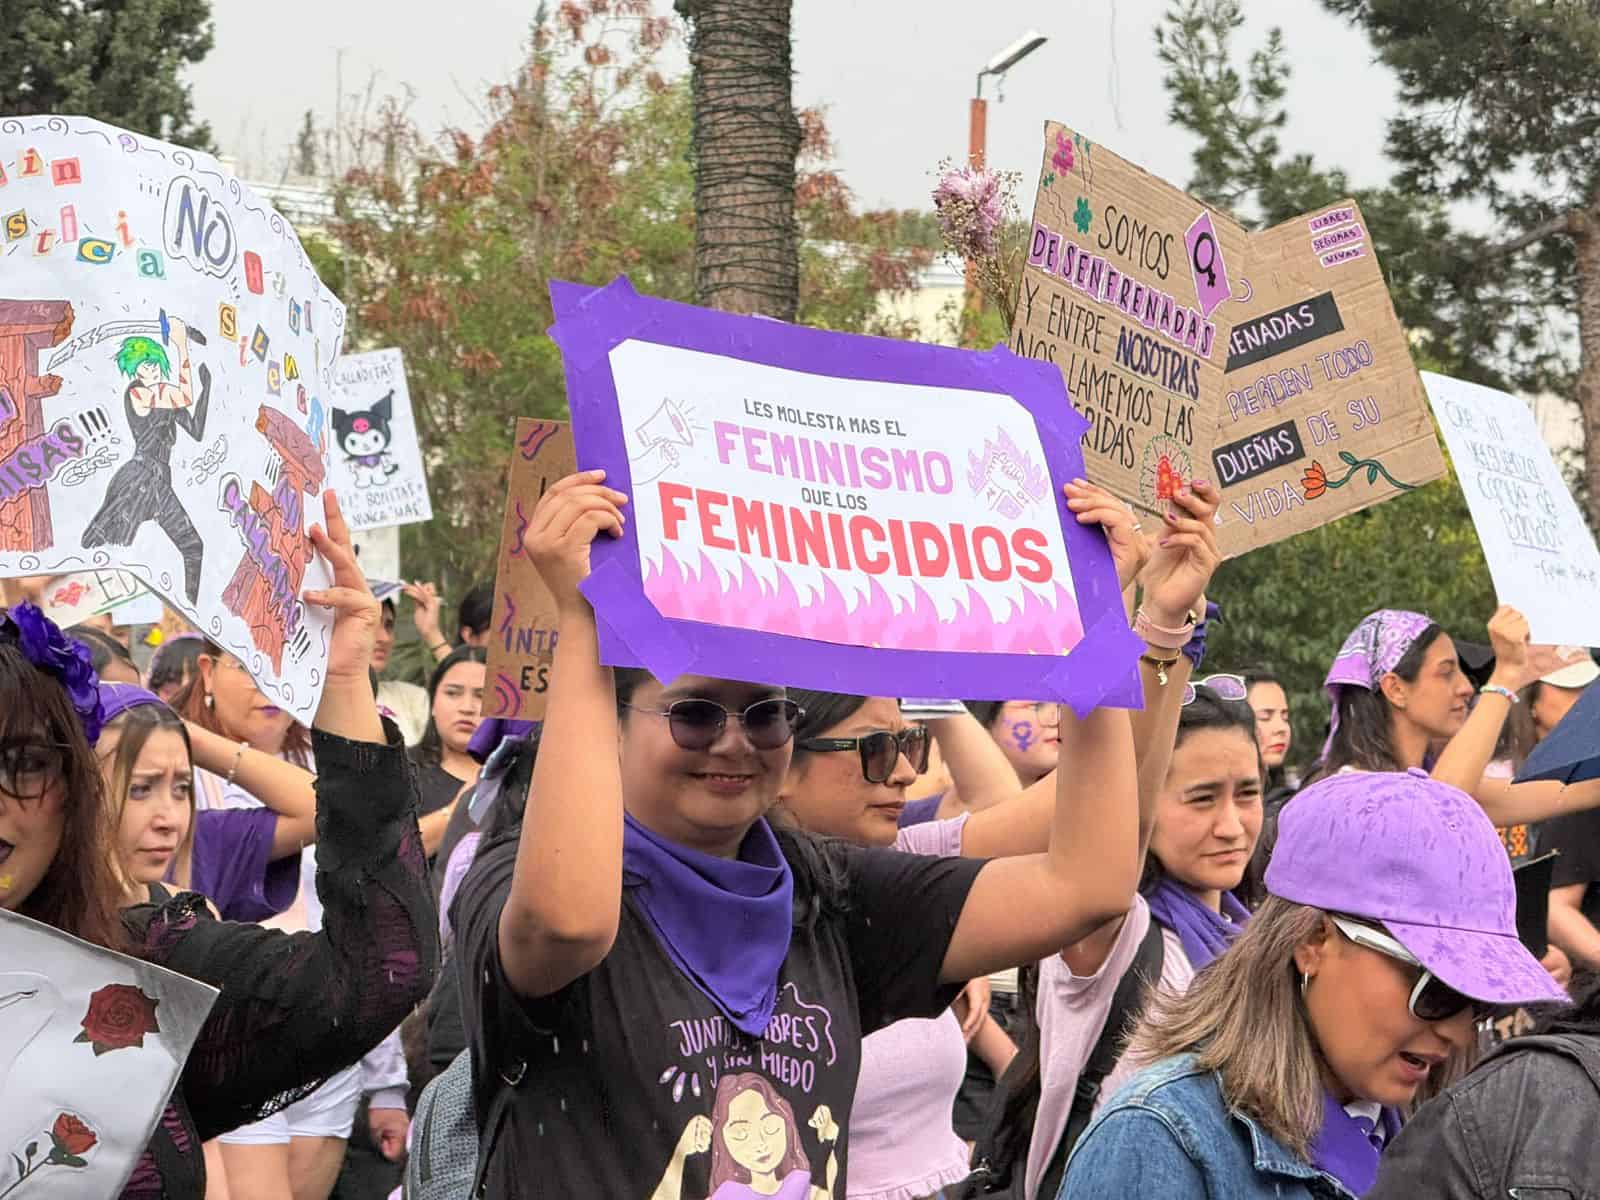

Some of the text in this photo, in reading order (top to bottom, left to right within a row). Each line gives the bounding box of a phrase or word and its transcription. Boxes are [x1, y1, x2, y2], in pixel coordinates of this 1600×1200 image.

[1098, 205, 1174, 280] SOMOS
[1313, 211, 1350, 229] LIBRES
[1313, 229, 1357, 250] SEGURAS
[1325, 248, 1361, 264] VIVAS
[1032, 229, 1211, 354] DESENFRENADAS
[1024, 277, 1200, 400] Y ENTRE NOSOTRAS
[1067, 352, 1154, 427] LAMEMOS
[1163, 396, 1194, 446] LAS
[1226, 339, 1374, 422] PERDEN TODO
[744, 398, 907, 437] LES MOLESTA MAS EL
[1074, 402, 1136, 469] RIDAS
[1216, 395, 1382, 482] DUEÑAS DE SU
[713, 420, 954, 494] FEMINISMO
[657, 481, 1053, 583] FEMINICIDIOS
[801, 487, 868, 511] QUE LOS
[1231, 480, 1305, 524] VIDA
[760, 1040, 815, 1093] MIEDO
